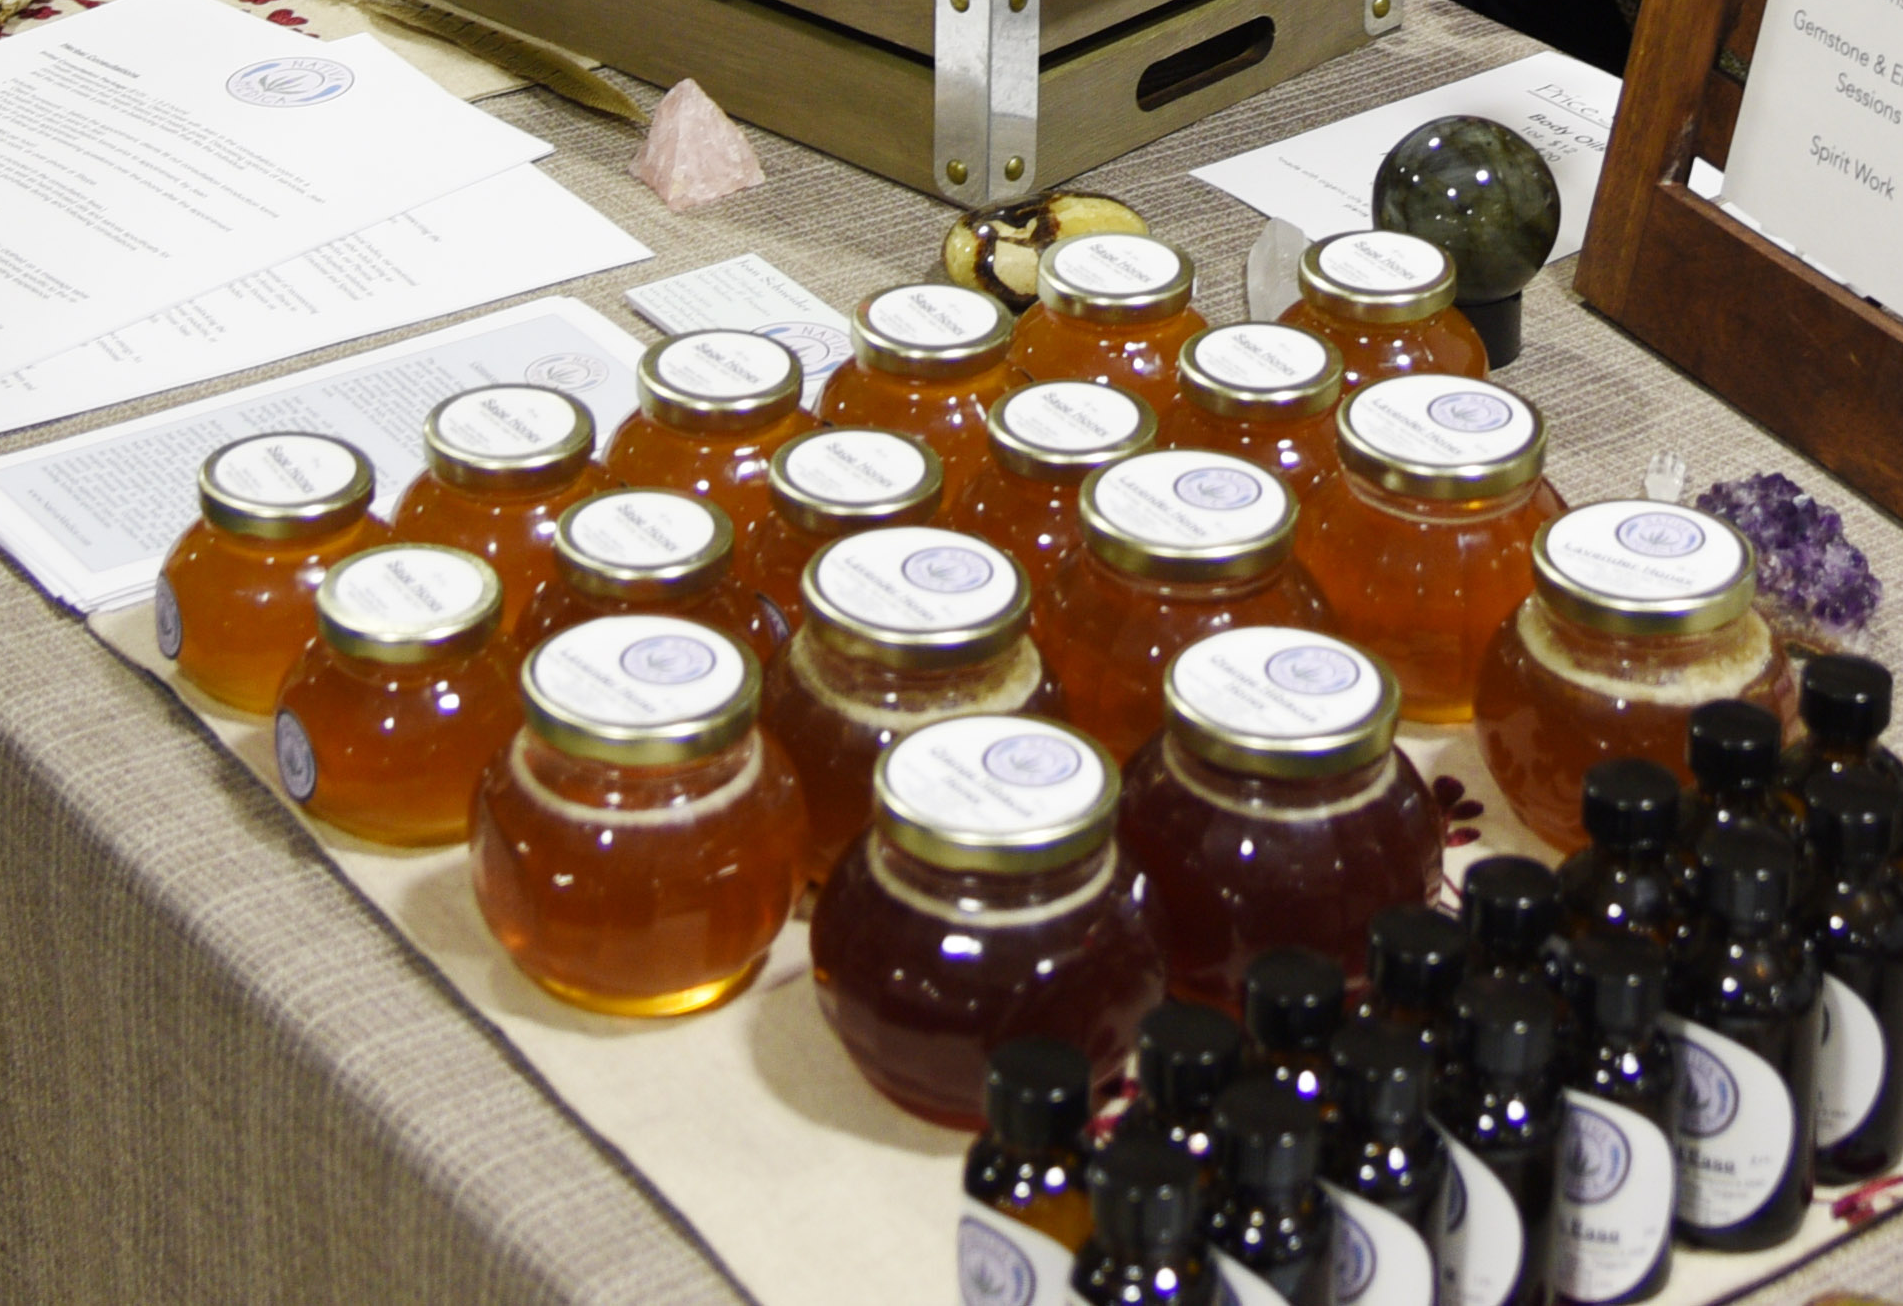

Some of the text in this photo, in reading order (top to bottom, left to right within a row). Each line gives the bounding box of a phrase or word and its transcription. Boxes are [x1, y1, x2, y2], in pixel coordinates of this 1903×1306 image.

[1793, 9, 1870, 68] Gemstone
[1873, 54, 1886, 77] &
[1534, 83, 1599, 118] Price
[1836, 72, 1902, 125] Sessions
[1528, 113, 1606, 152] Body Oils
[1548, 140, 1578, 155] $12
[1809, 135, 1896, 202] Spirit Work
